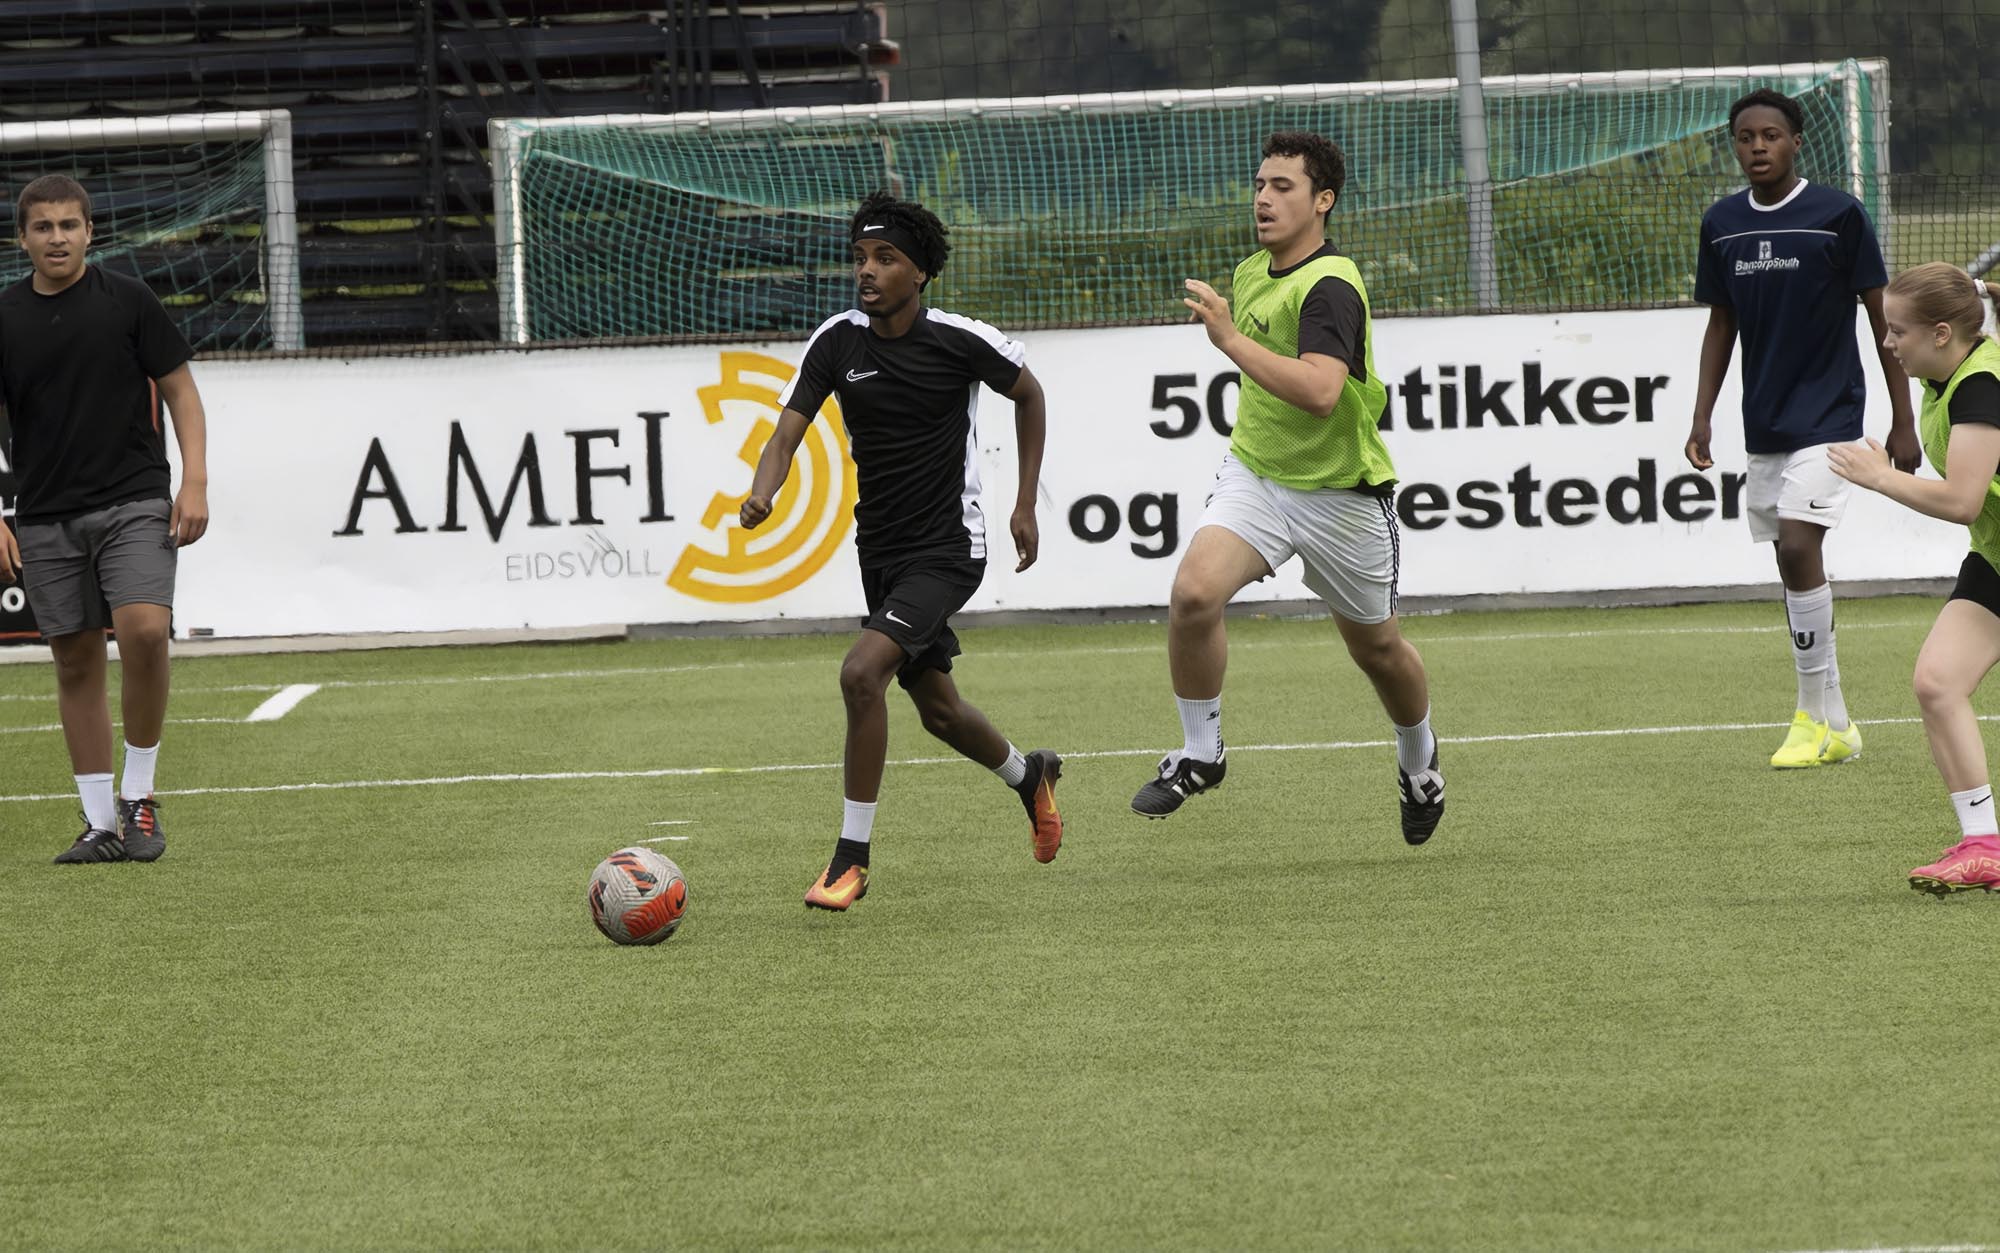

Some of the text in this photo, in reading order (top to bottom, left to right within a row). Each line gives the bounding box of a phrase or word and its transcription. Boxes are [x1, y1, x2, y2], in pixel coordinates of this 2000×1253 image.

[1735, 257, 1800, 271] BancorpSouth
[1149, 361, 1670, 439] 50 tikker
[332, 411, 675, 543] AMFI
[1068, 458, 1748, 560] og esteder
[505, 549, 662, 582] EIDSVOLL
